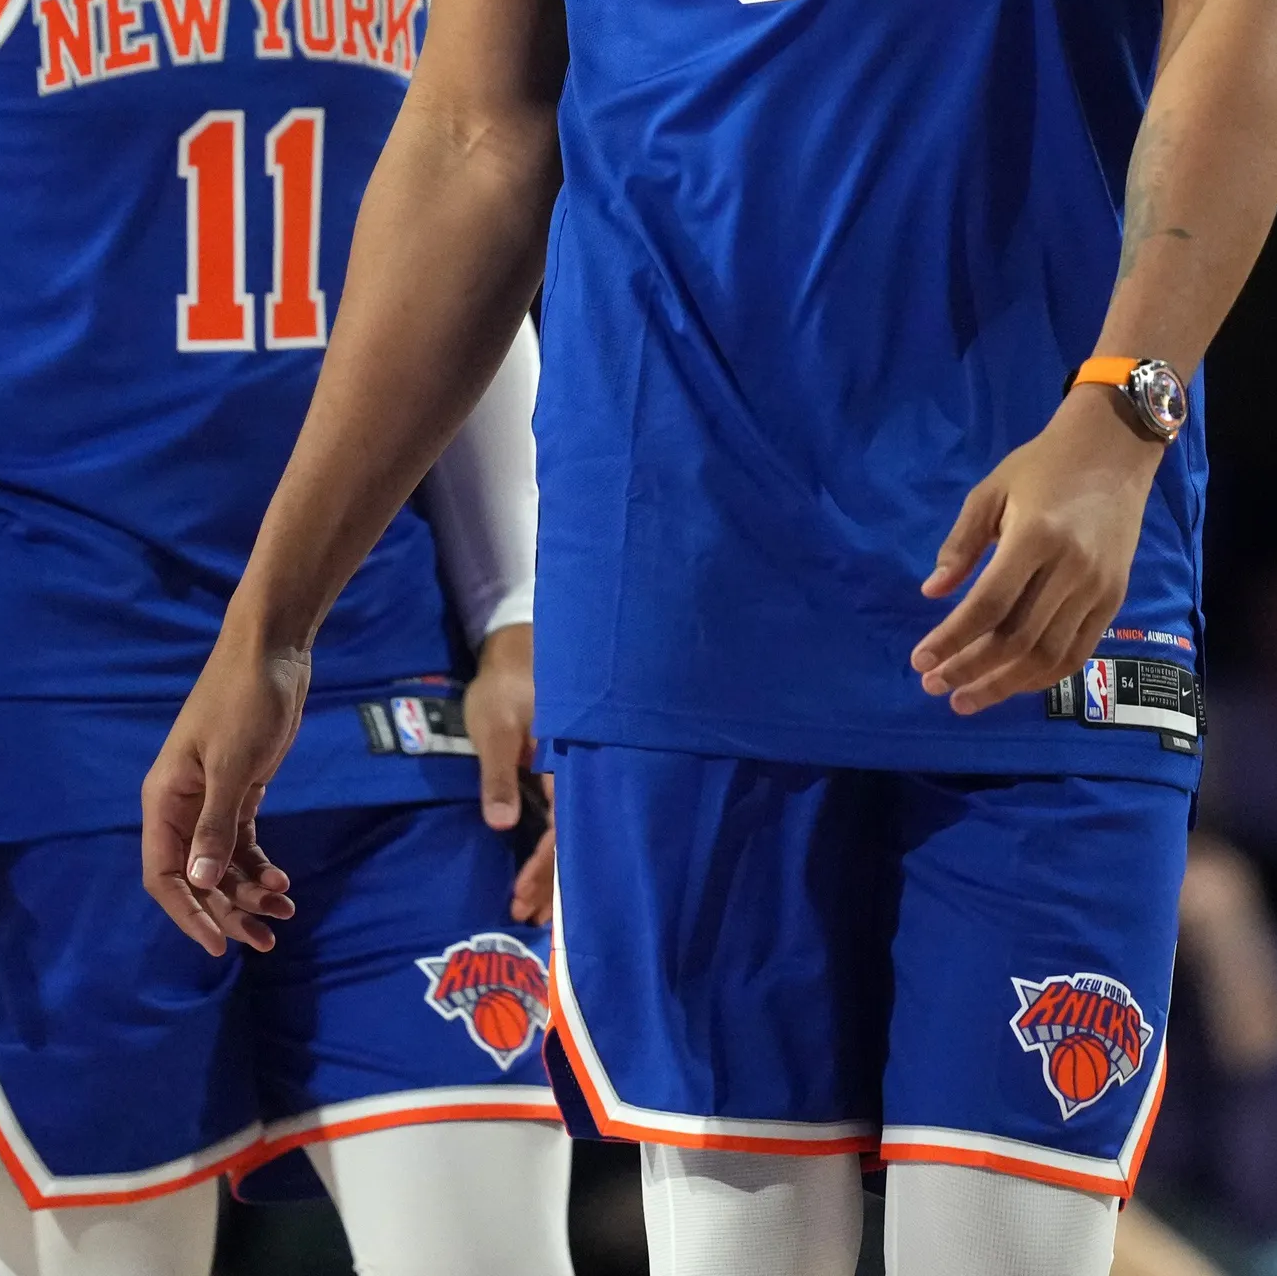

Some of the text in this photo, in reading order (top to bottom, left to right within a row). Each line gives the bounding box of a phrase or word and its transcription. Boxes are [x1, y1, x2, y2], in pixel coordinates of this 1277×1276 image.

[177, 108, 328, 352] 11
[1121, 677, 1134, 688] 54
[1074, 977, 1128, 1006] NEW YORK
[1017, 981, 1141, 1069] KNICKS
